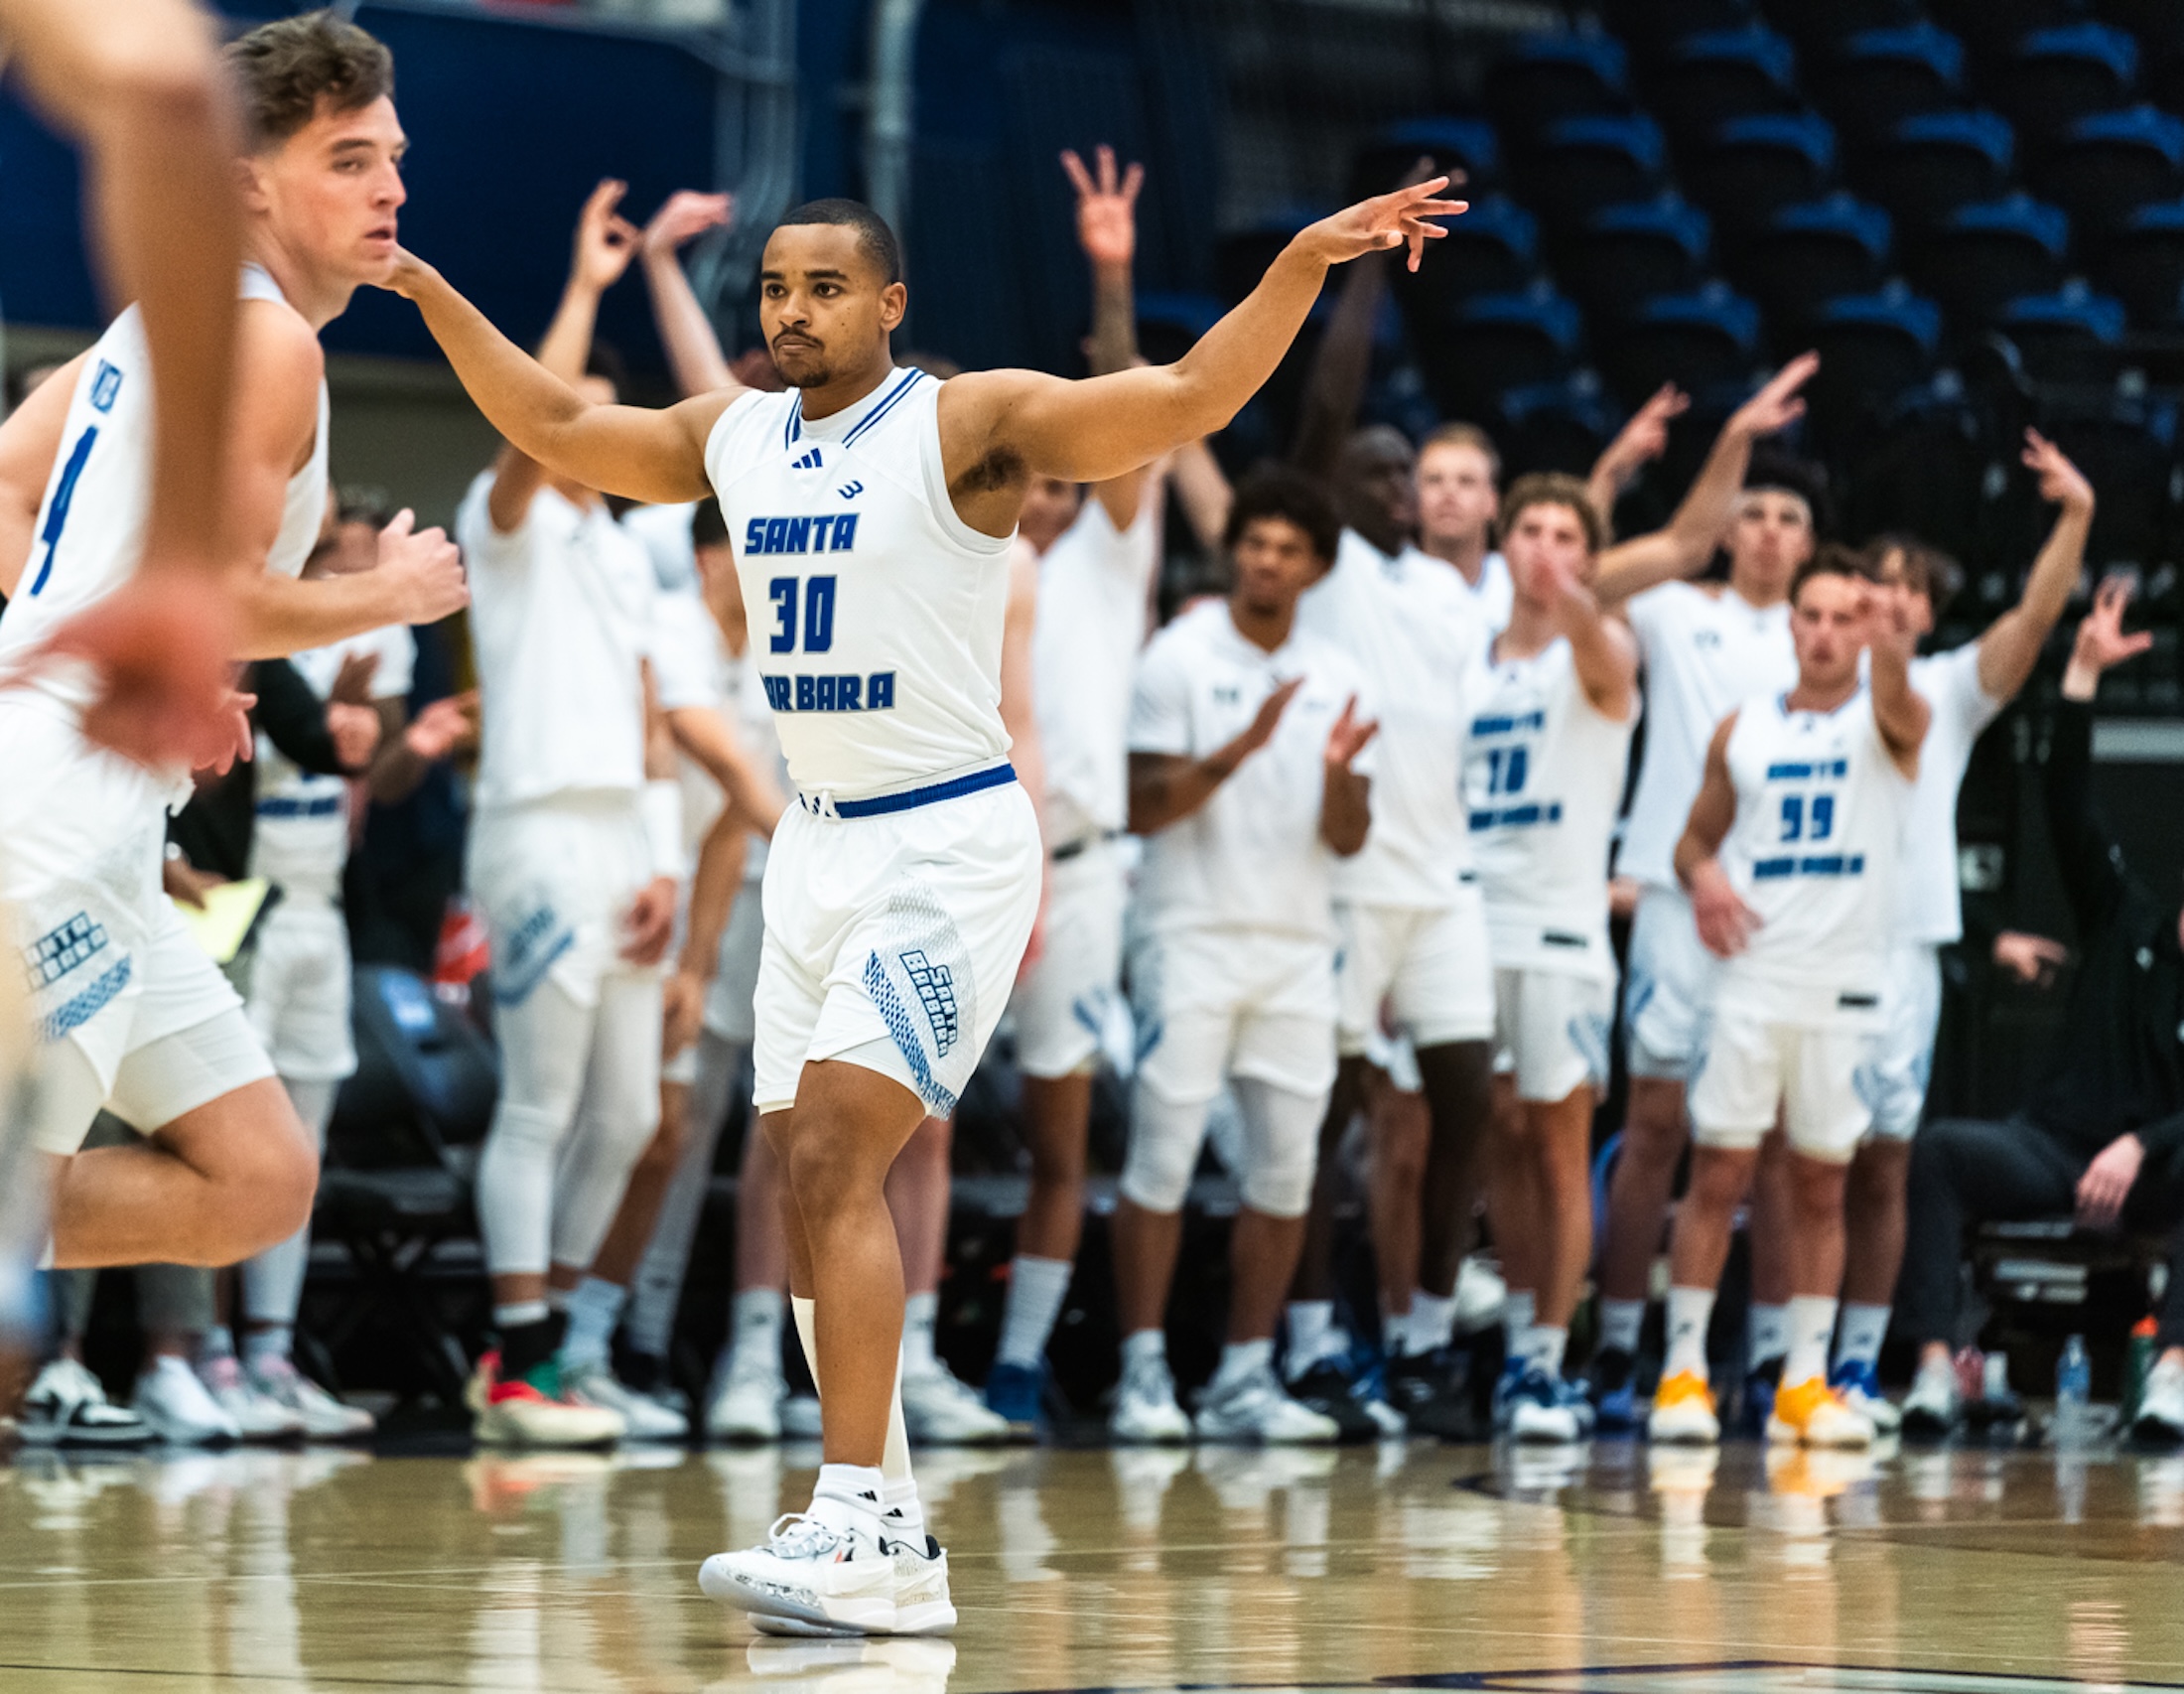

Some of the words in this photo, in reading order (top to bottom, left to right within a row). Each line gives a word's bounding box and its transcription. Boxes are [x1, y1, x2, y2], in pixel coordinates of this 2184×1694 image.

[745, 512, 861, 557] SANTA
[768, 574, 838, 655] 30
[900, 950, 948, 1058] BARBARA
[929, 965, 957, 1045] SANTA
